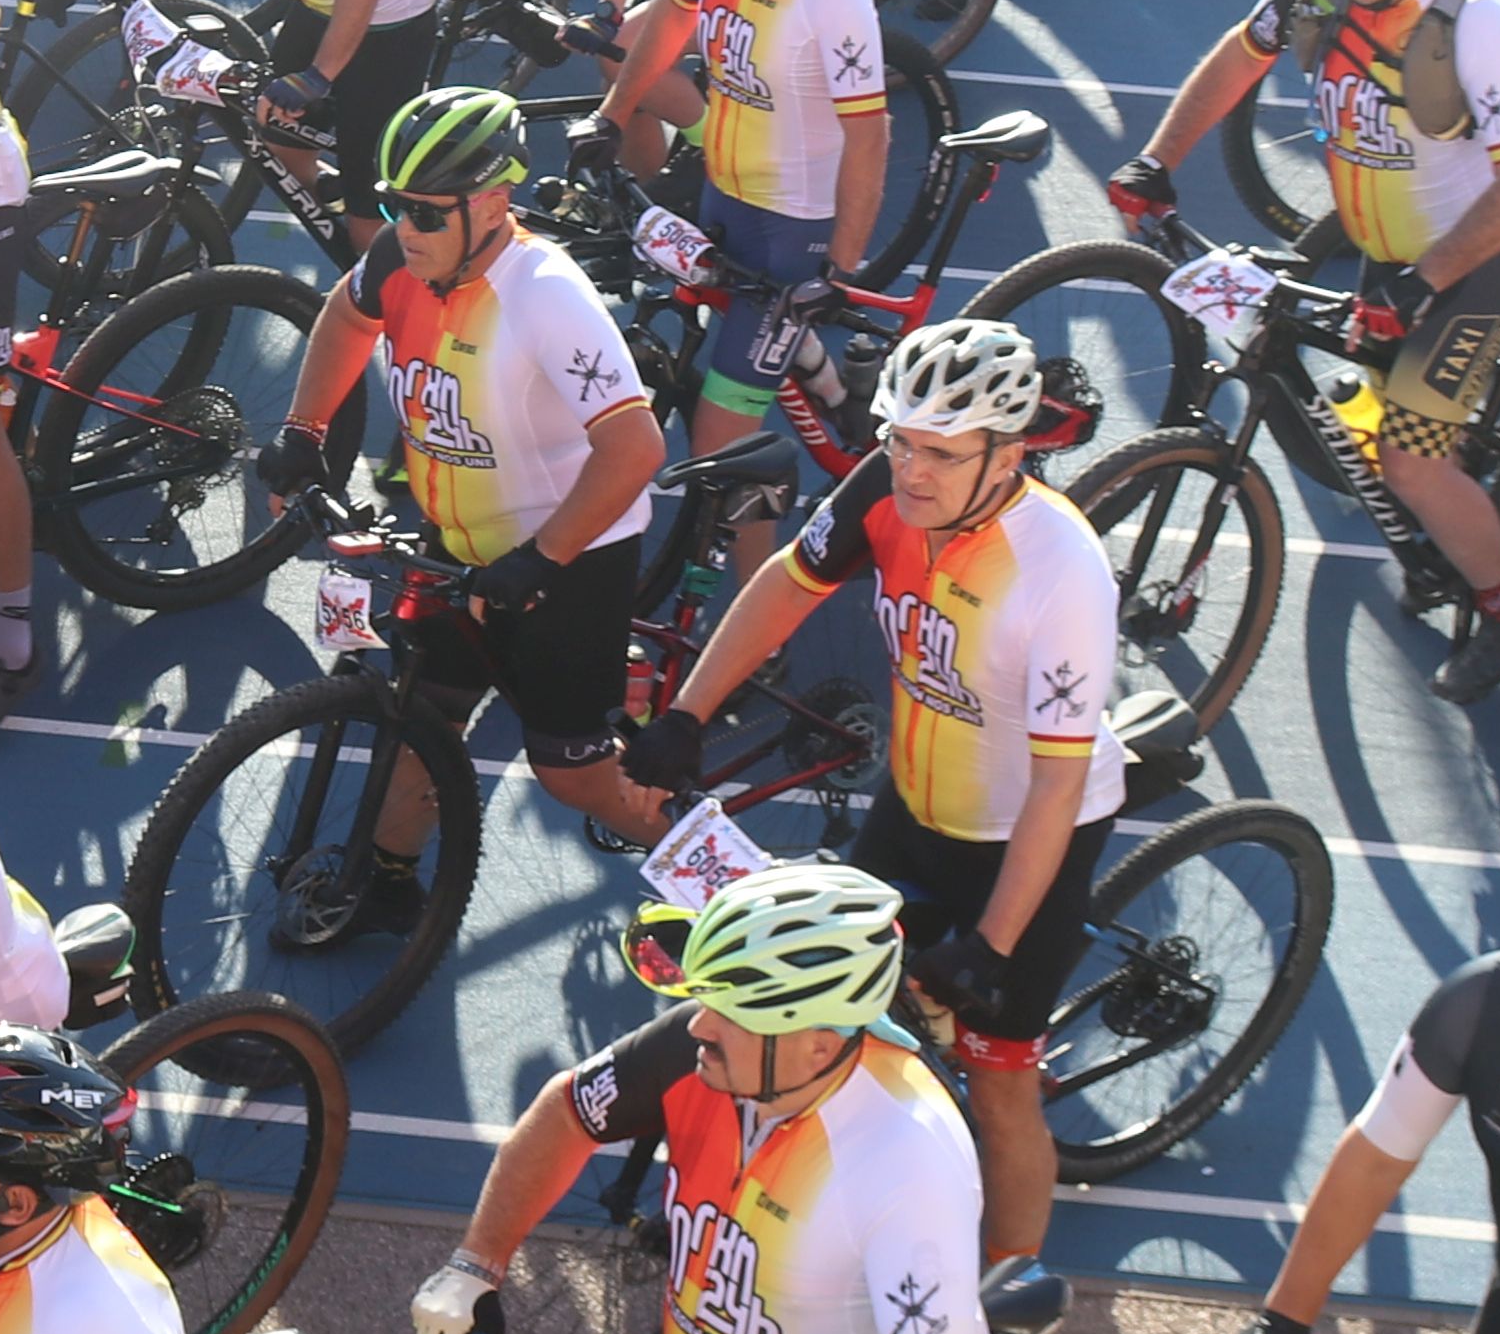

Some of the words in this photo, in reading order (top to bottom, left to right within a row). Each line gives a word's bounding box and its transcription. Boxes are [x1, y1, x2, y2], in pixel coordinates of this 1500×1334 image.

[657, 221, 702, 260] 5065
[1436, 325, 1486, 395] TAXI
[41, 1083, 106, 1109] MET
